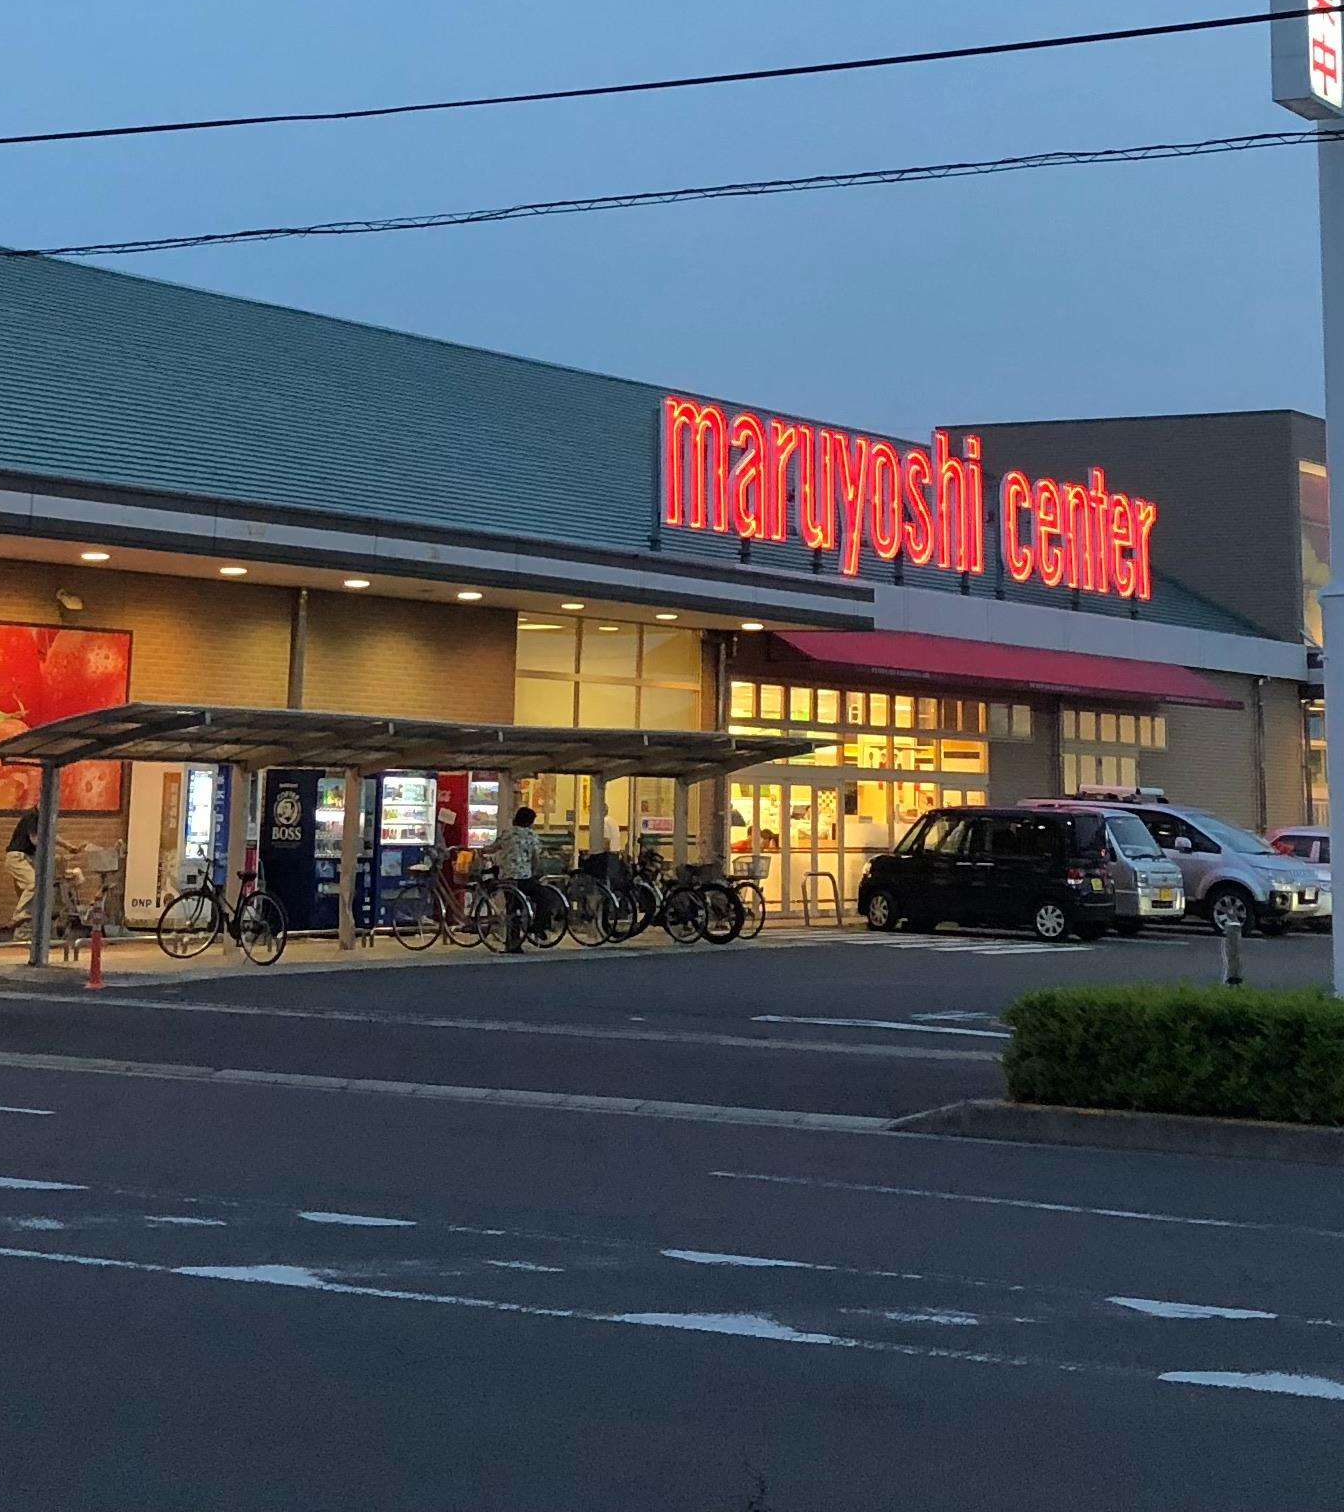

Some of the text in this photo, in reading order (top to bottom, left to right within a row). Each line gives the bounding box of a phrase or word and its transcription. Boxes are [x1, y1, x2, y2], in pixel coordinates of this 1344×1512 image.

[661, 395, 1157, 601] maruyoshi center
[271, 826, 302, 841] BOSS
[131, 897, 152, 909] DNP
